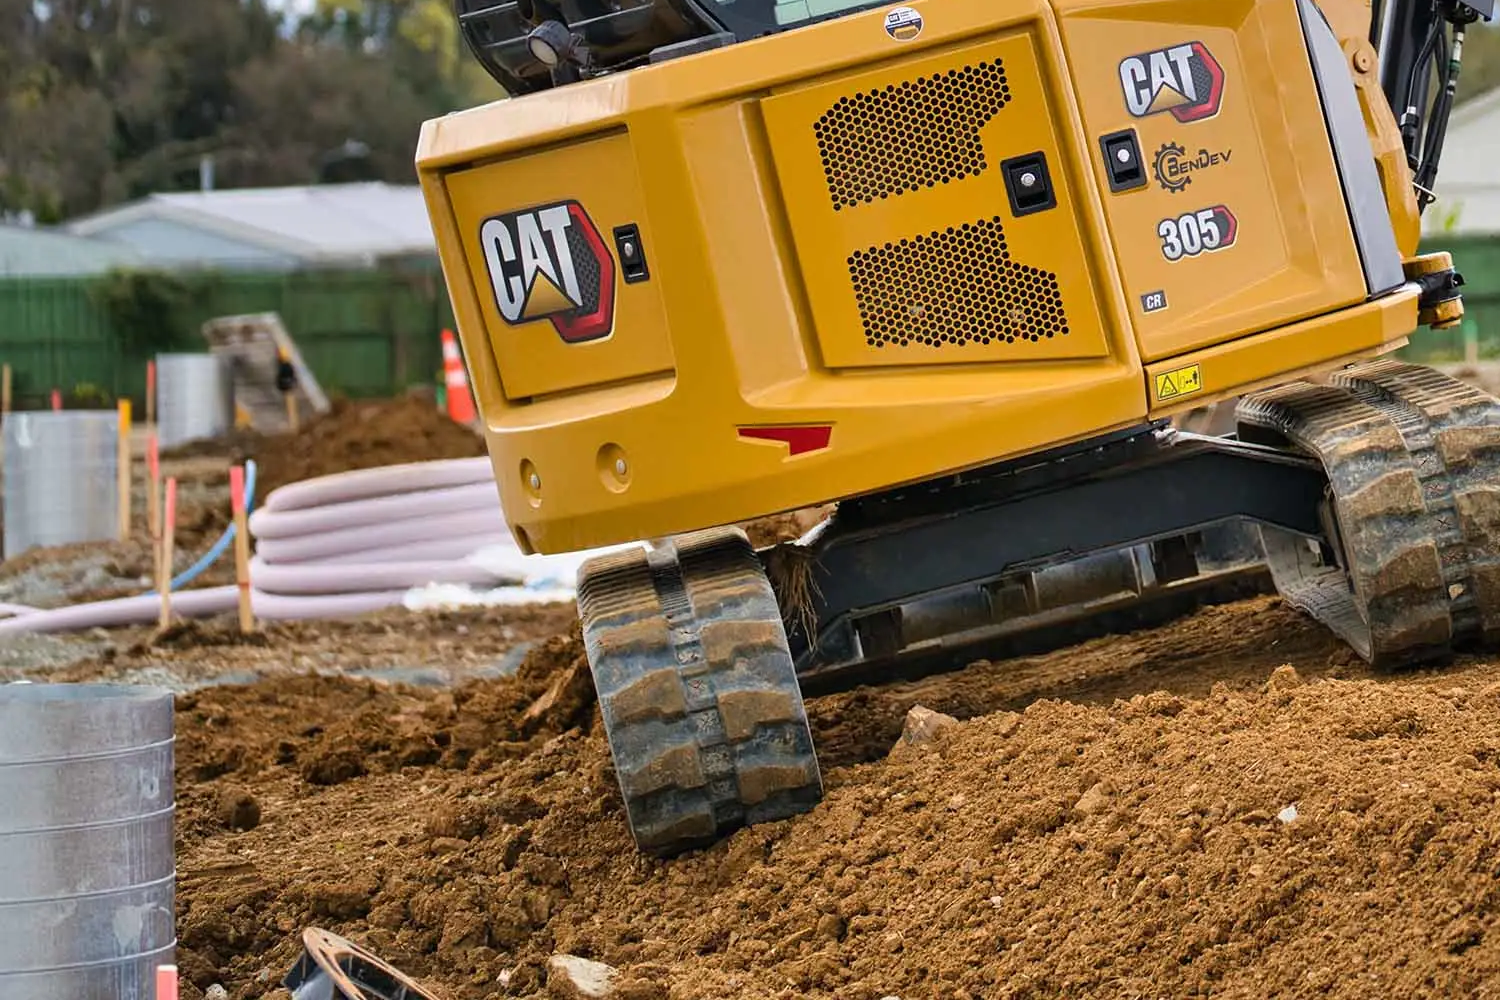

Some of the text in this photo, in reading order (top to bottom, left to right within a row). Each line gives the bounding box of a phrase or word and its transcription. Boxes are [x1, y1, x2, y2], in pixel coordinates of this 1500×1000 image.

[1120, 44, 1197, 115] CAT
[481, 205, 583, 320] CAT
[1159, 209, 1220, 261] 305
[1146, 294, 1162, 309] CR
